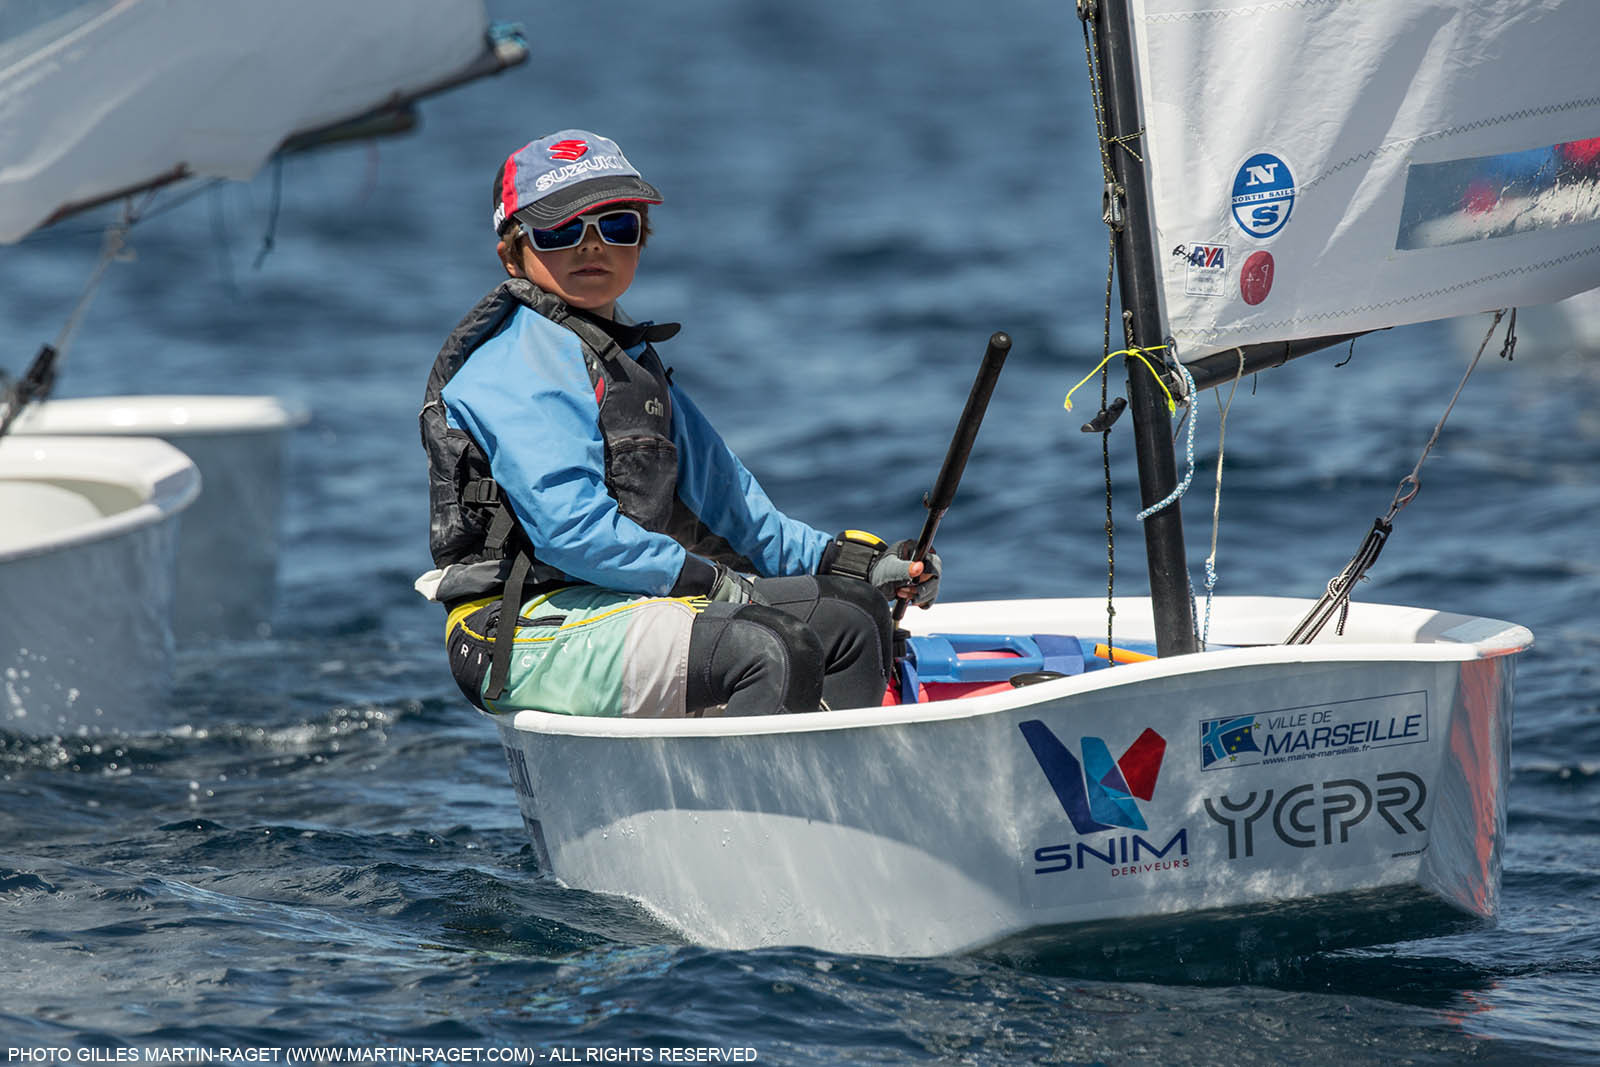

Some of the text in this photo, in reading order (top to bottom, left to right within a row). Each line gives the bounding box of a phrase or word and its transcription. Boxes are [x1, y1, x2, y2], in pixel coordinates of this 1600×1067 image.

[536, 156, 623, 191] SUZUKI
[1246, 163, 1278, 186] N
[1232, 189, 1296, 203] NORTH SAILS
[1252, 205, 1279, 227] S
[1190, 246, 1225, 268] RYA
[1267, 710, 1333, 730] VILLE DE
[1264, 714, 1422, 756] MARSEILLE
[1262, 744, 1371, 766] www.mairie-marseille.fr
[1204, 771, 1427, 860] YCPR
[1034, 828, 1188, 875] SNIM
[1111, 858, 1190, 877] DERIVEURS
